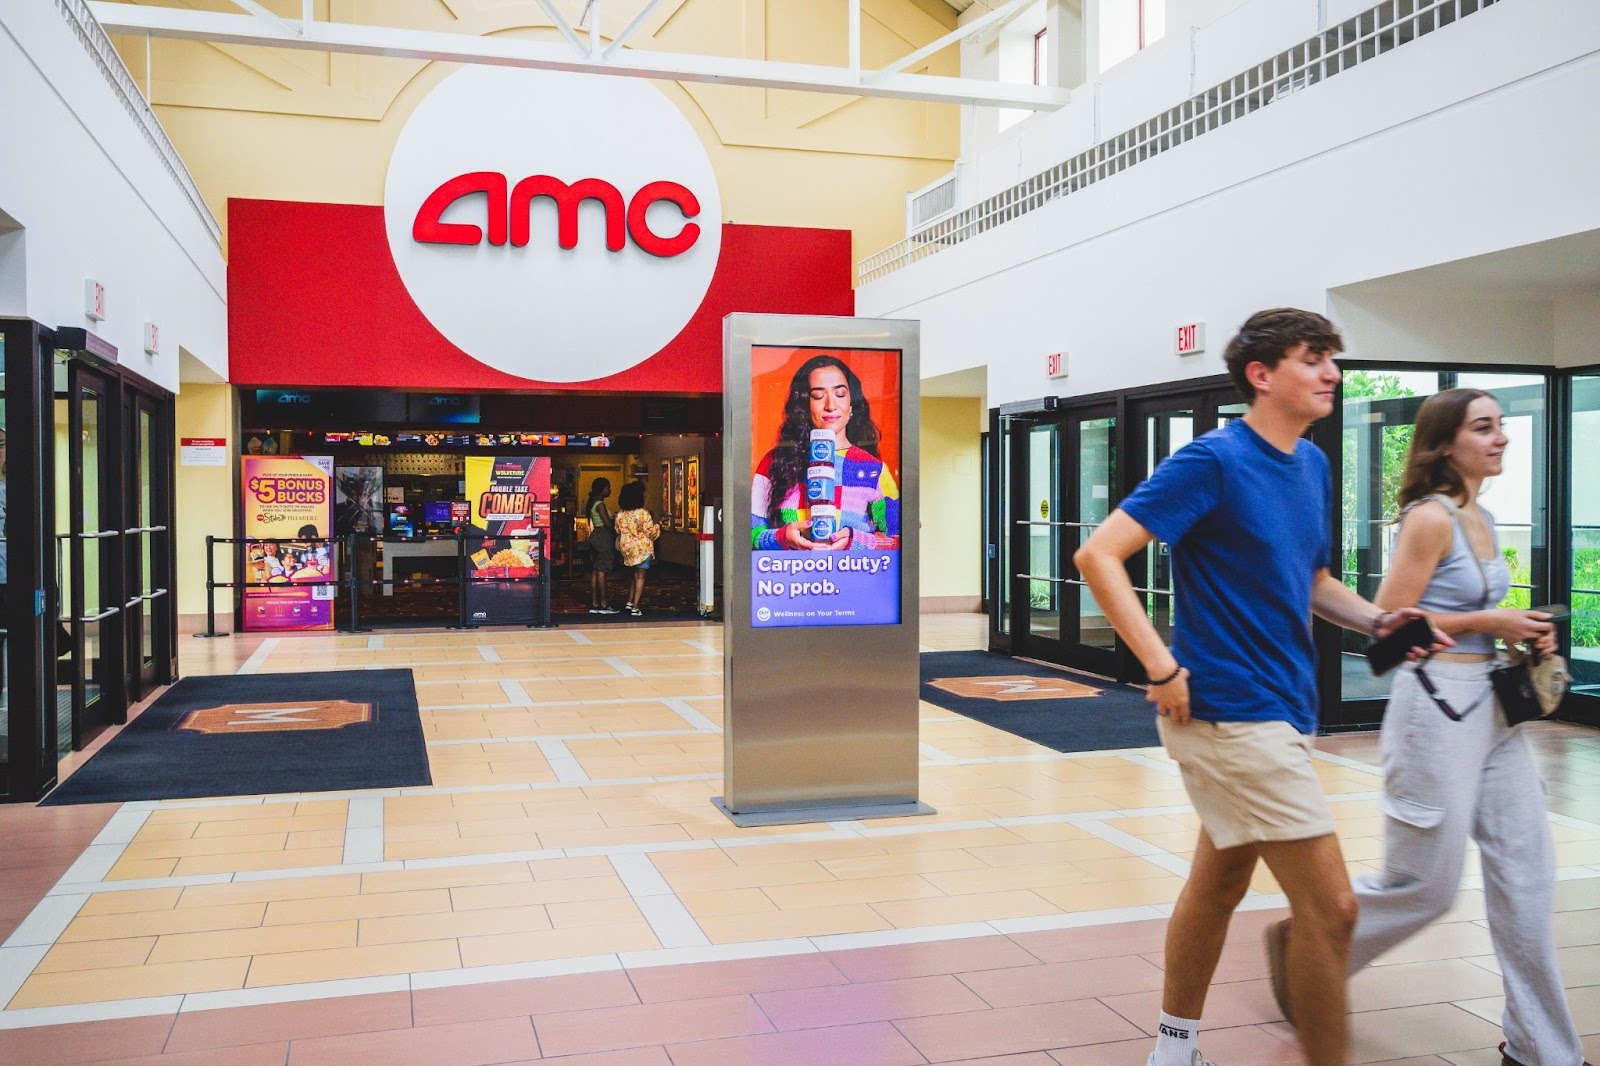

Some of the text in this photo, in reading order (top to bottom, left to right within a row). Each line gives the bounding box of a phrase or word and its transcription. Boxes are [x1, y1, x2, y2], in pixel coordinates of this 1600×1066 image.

[1178, 324, 1196, 351] EXIT
[1048, 353, 1061, 376] EXIT
[251, 479, 322, 502] $5 BONUS
[278, 492, 322, 502] BUCKS
[480, 493, 536, 517] COMBO
[758, 555, 891, 574] Carpool duty?
[758, 578, 840, 598] No prob.
